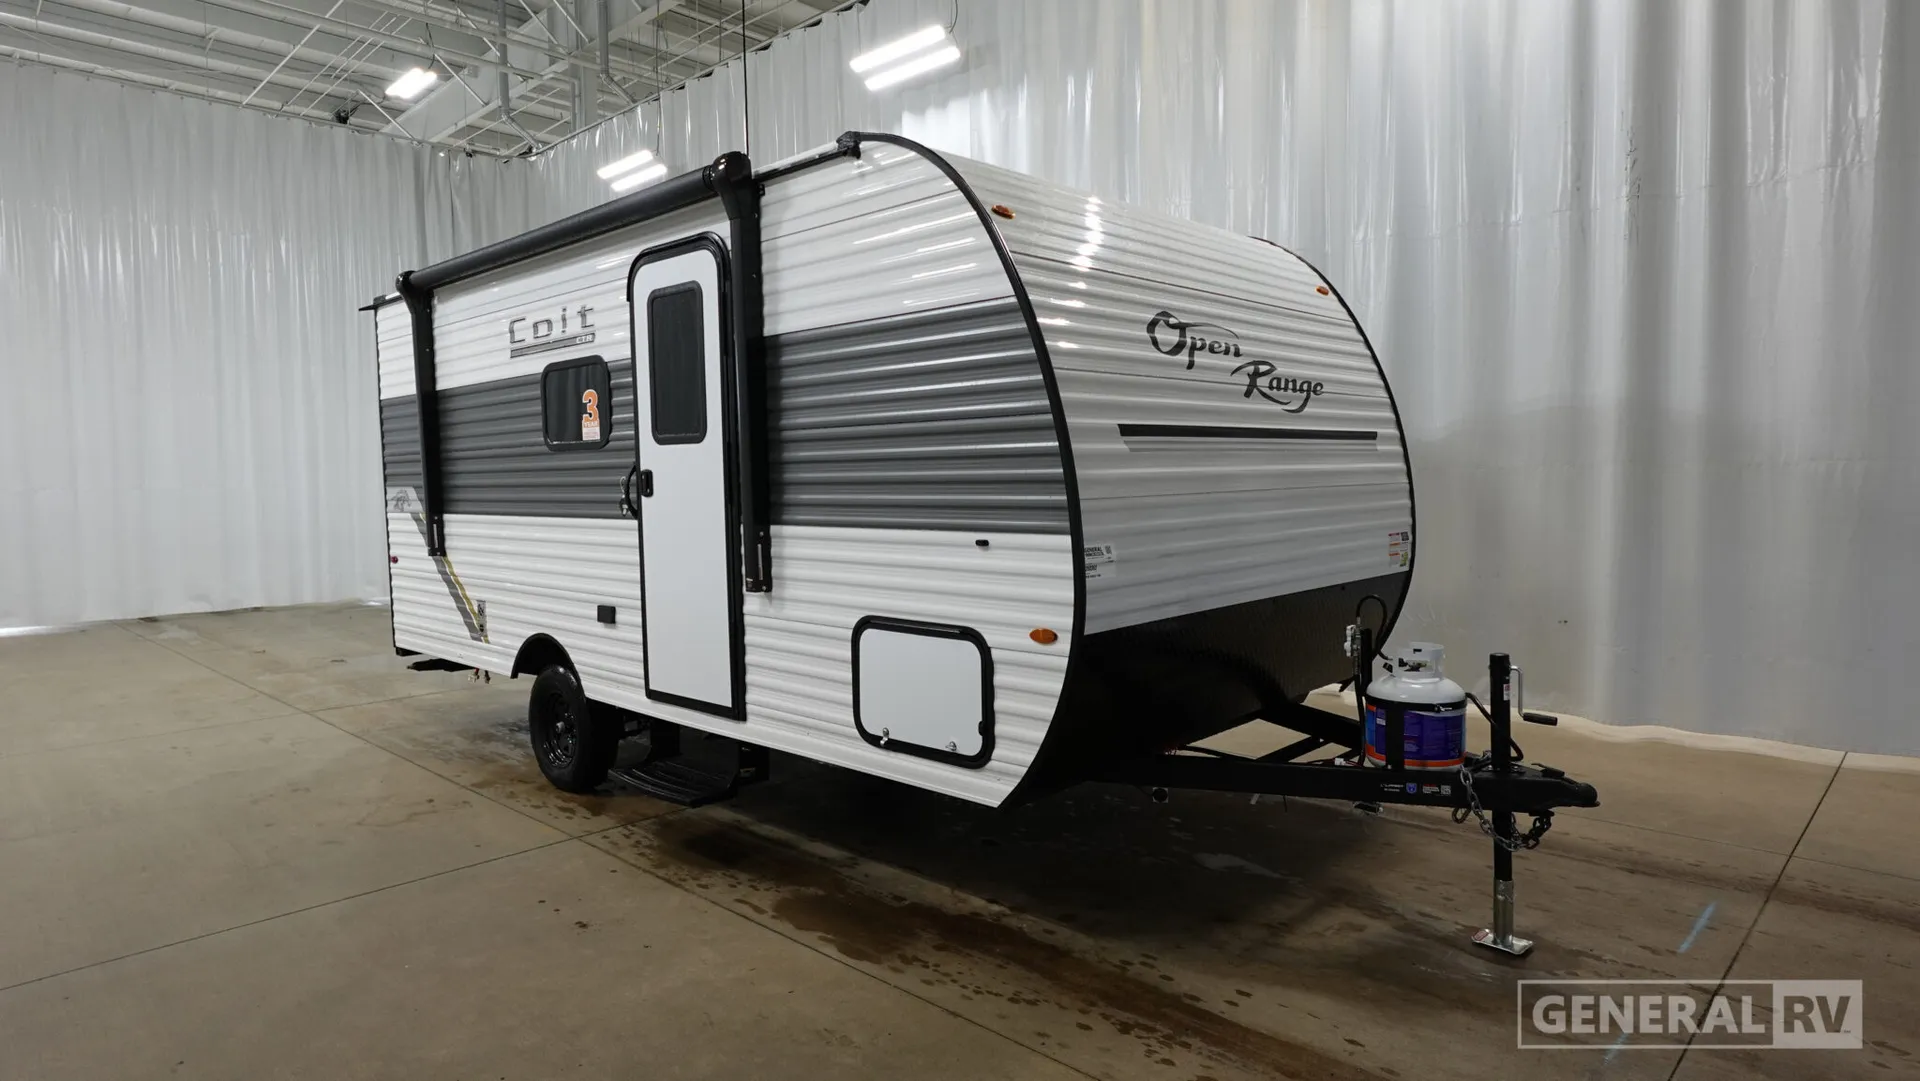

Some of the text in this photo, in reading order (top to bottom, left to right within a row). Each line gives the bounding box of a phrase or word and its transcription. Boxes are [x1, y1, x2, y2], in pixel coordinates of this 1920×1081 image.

[1146, 310, 1243, 370] Open
[582, 389, 599, 422] 3
[1230, 360, 1324, 413] Range
